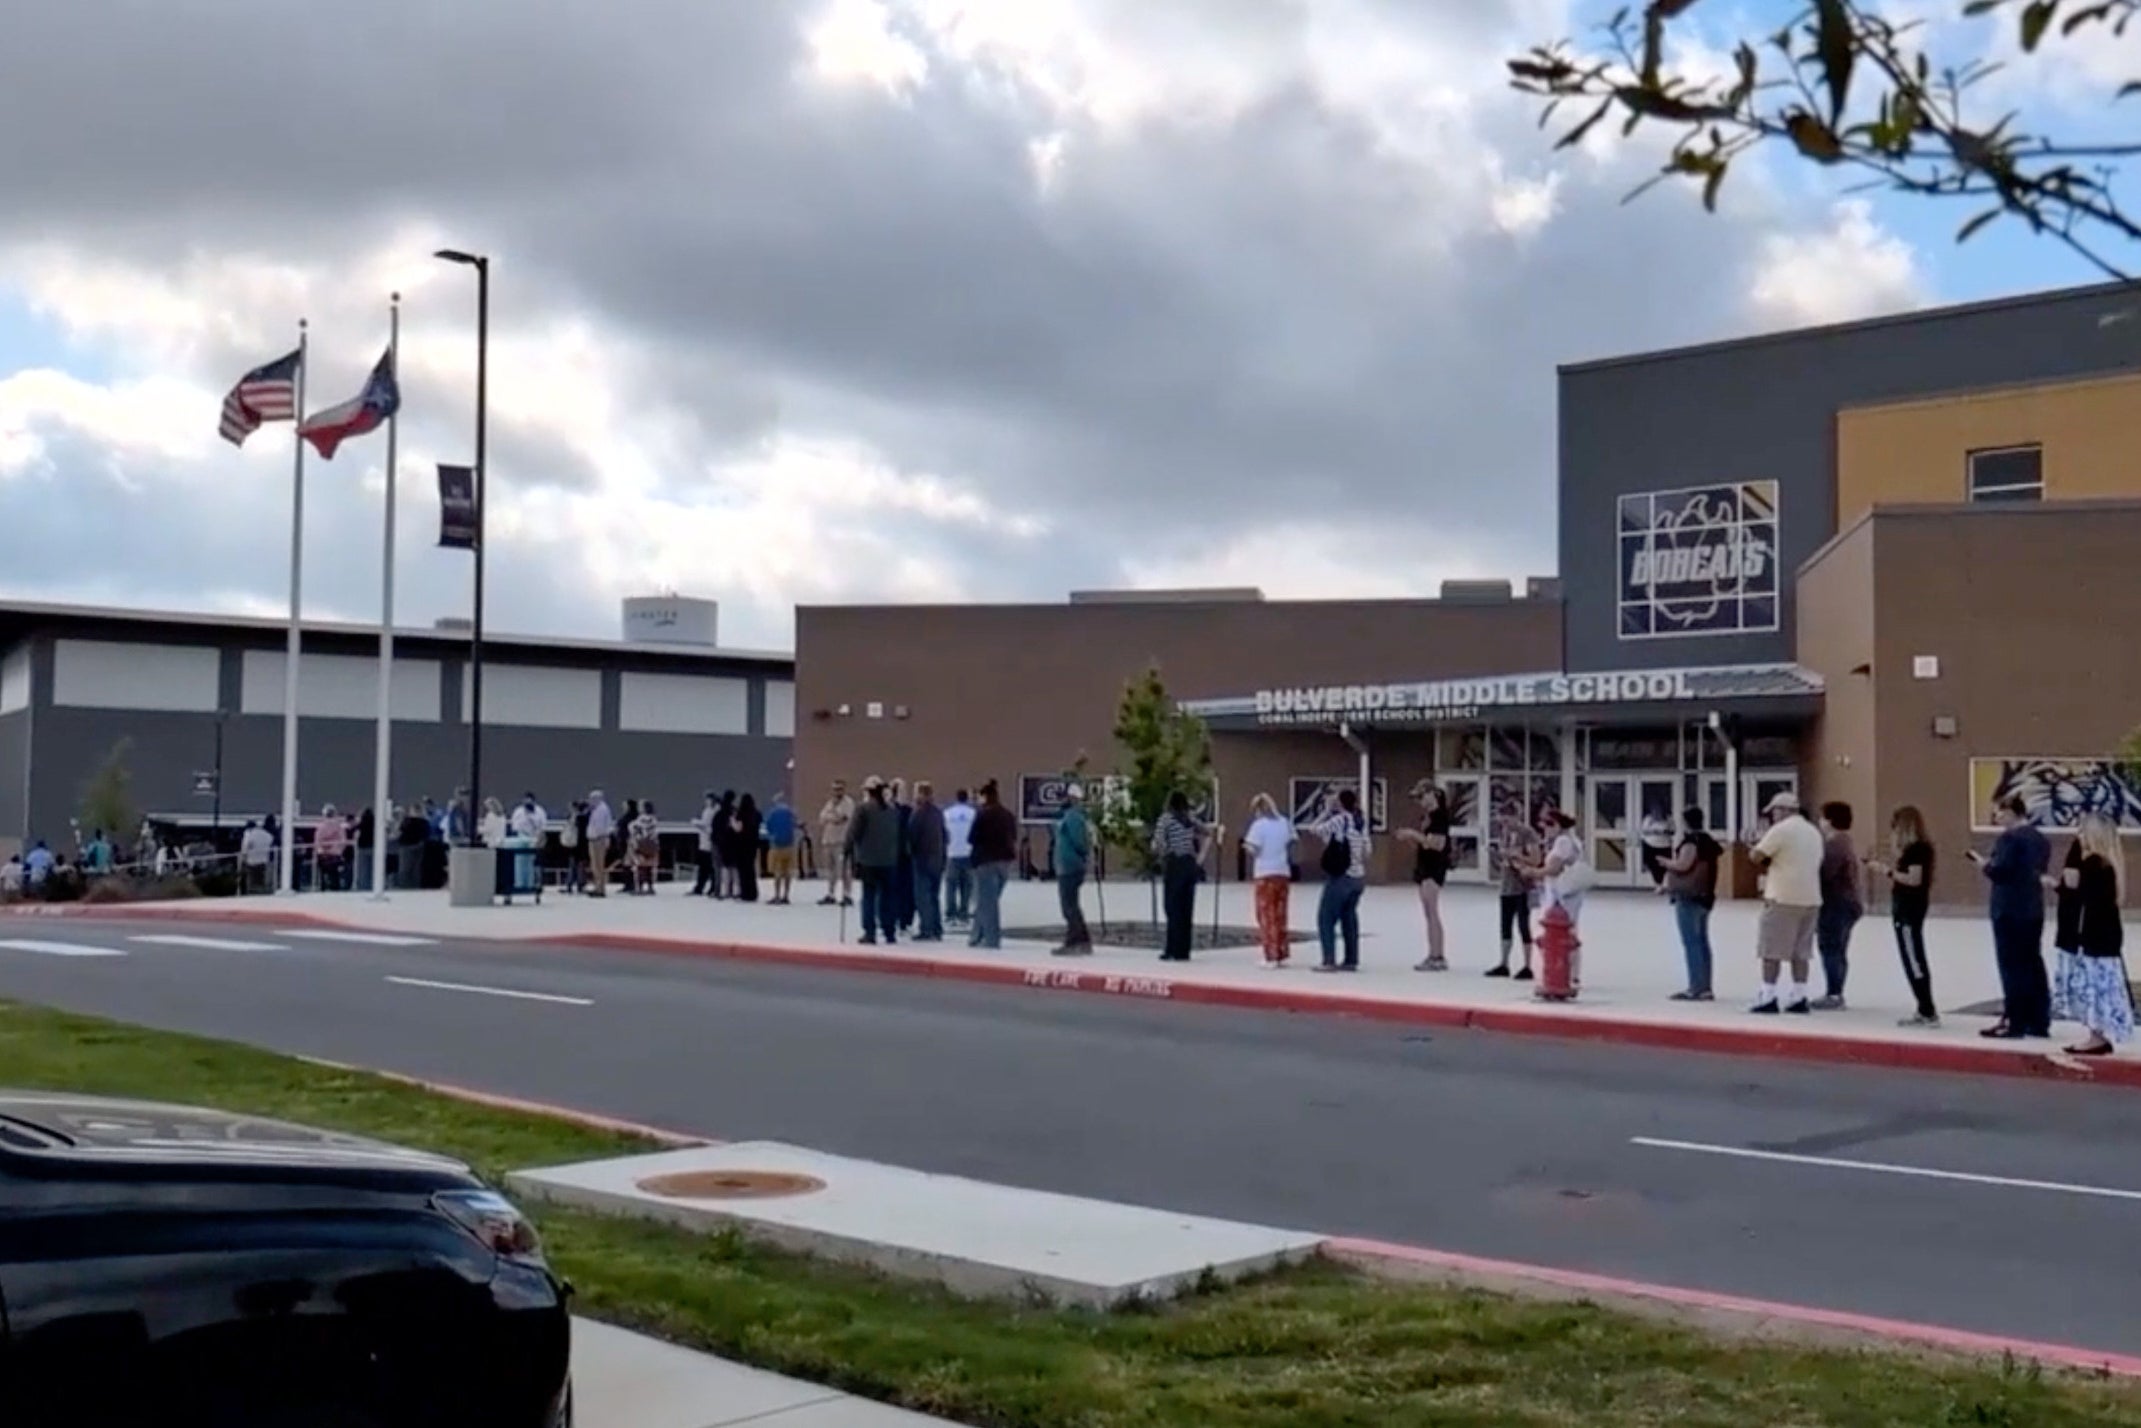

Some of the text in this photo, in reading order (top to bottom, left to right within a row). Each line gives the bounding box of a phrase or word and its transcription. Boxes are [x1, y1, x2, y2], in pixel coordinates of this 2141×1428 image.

[1630, 540, 1767, 586] BOBCATS
[1255, 669, 1694, 712] BULVERDE MIDDLE SCHOOL
